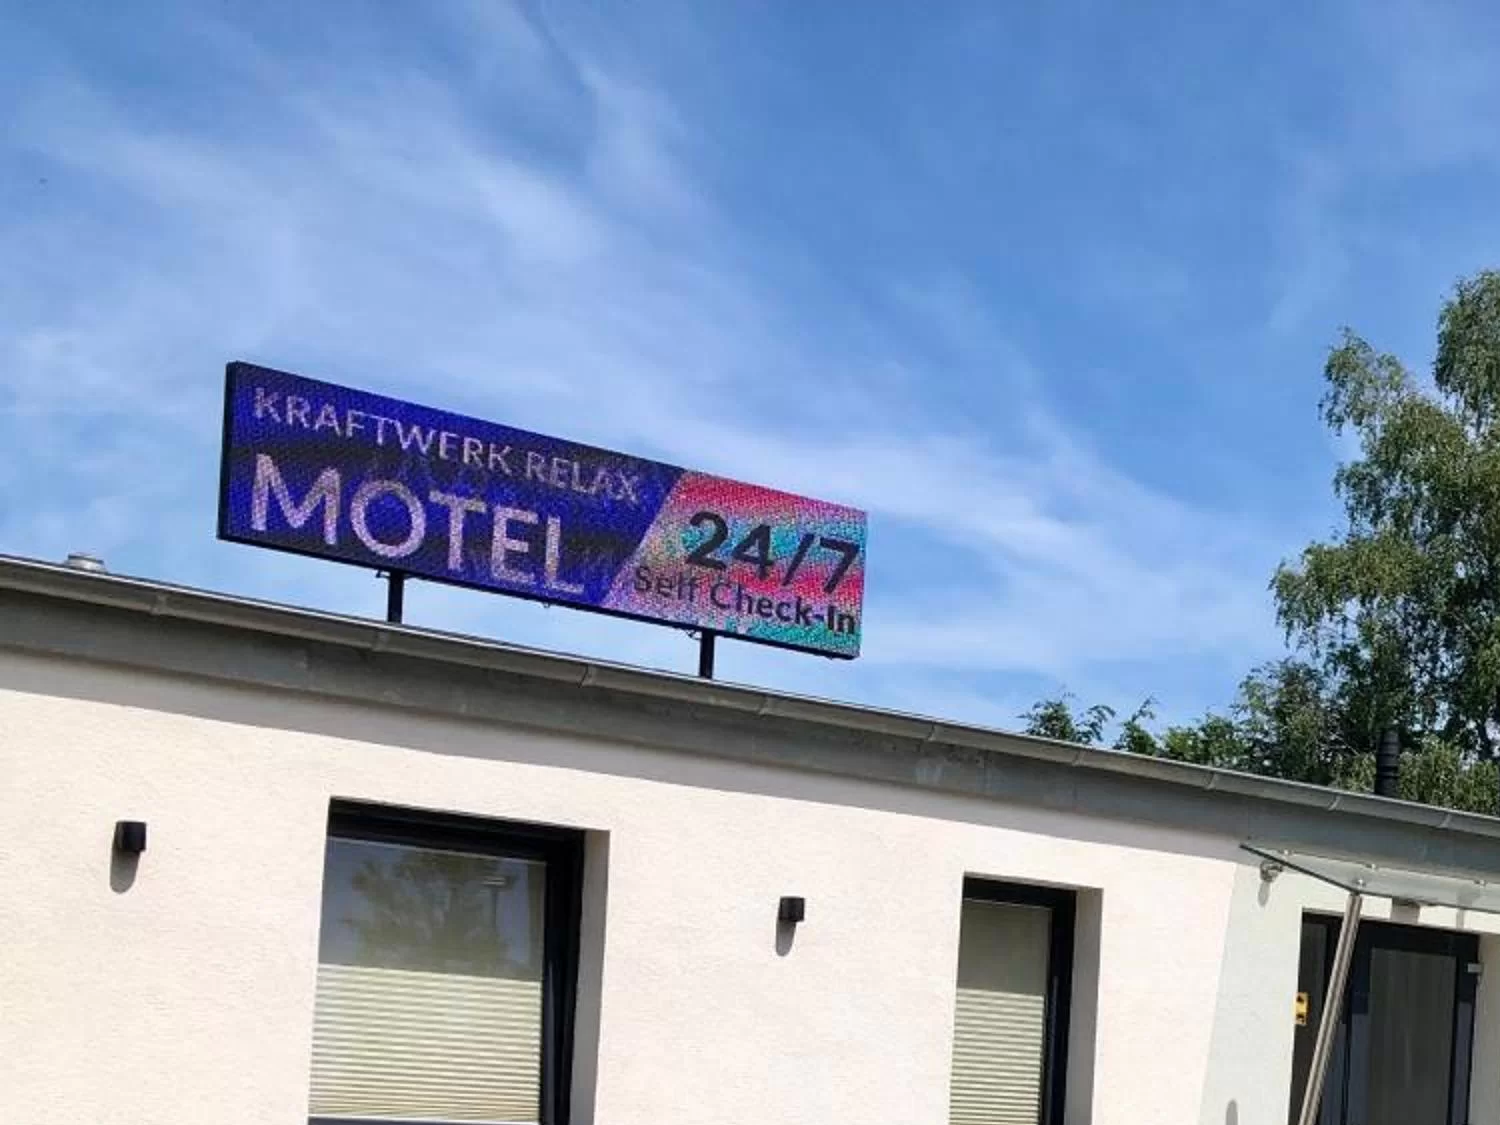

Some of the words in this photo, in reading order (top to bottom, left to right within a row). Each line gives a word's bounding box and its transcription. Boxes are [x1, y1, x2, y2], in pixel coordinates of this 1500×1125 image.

[253, 386, 512, 474] KRAFTWERK
[525, 453, 640, 503] RELAX
[250, 453, 585, 595] MOTEL
[685, 510, 861, 594] 24/7
[633, 564, 700, 602] Self
[709, 581, 857, 635] Check-In
